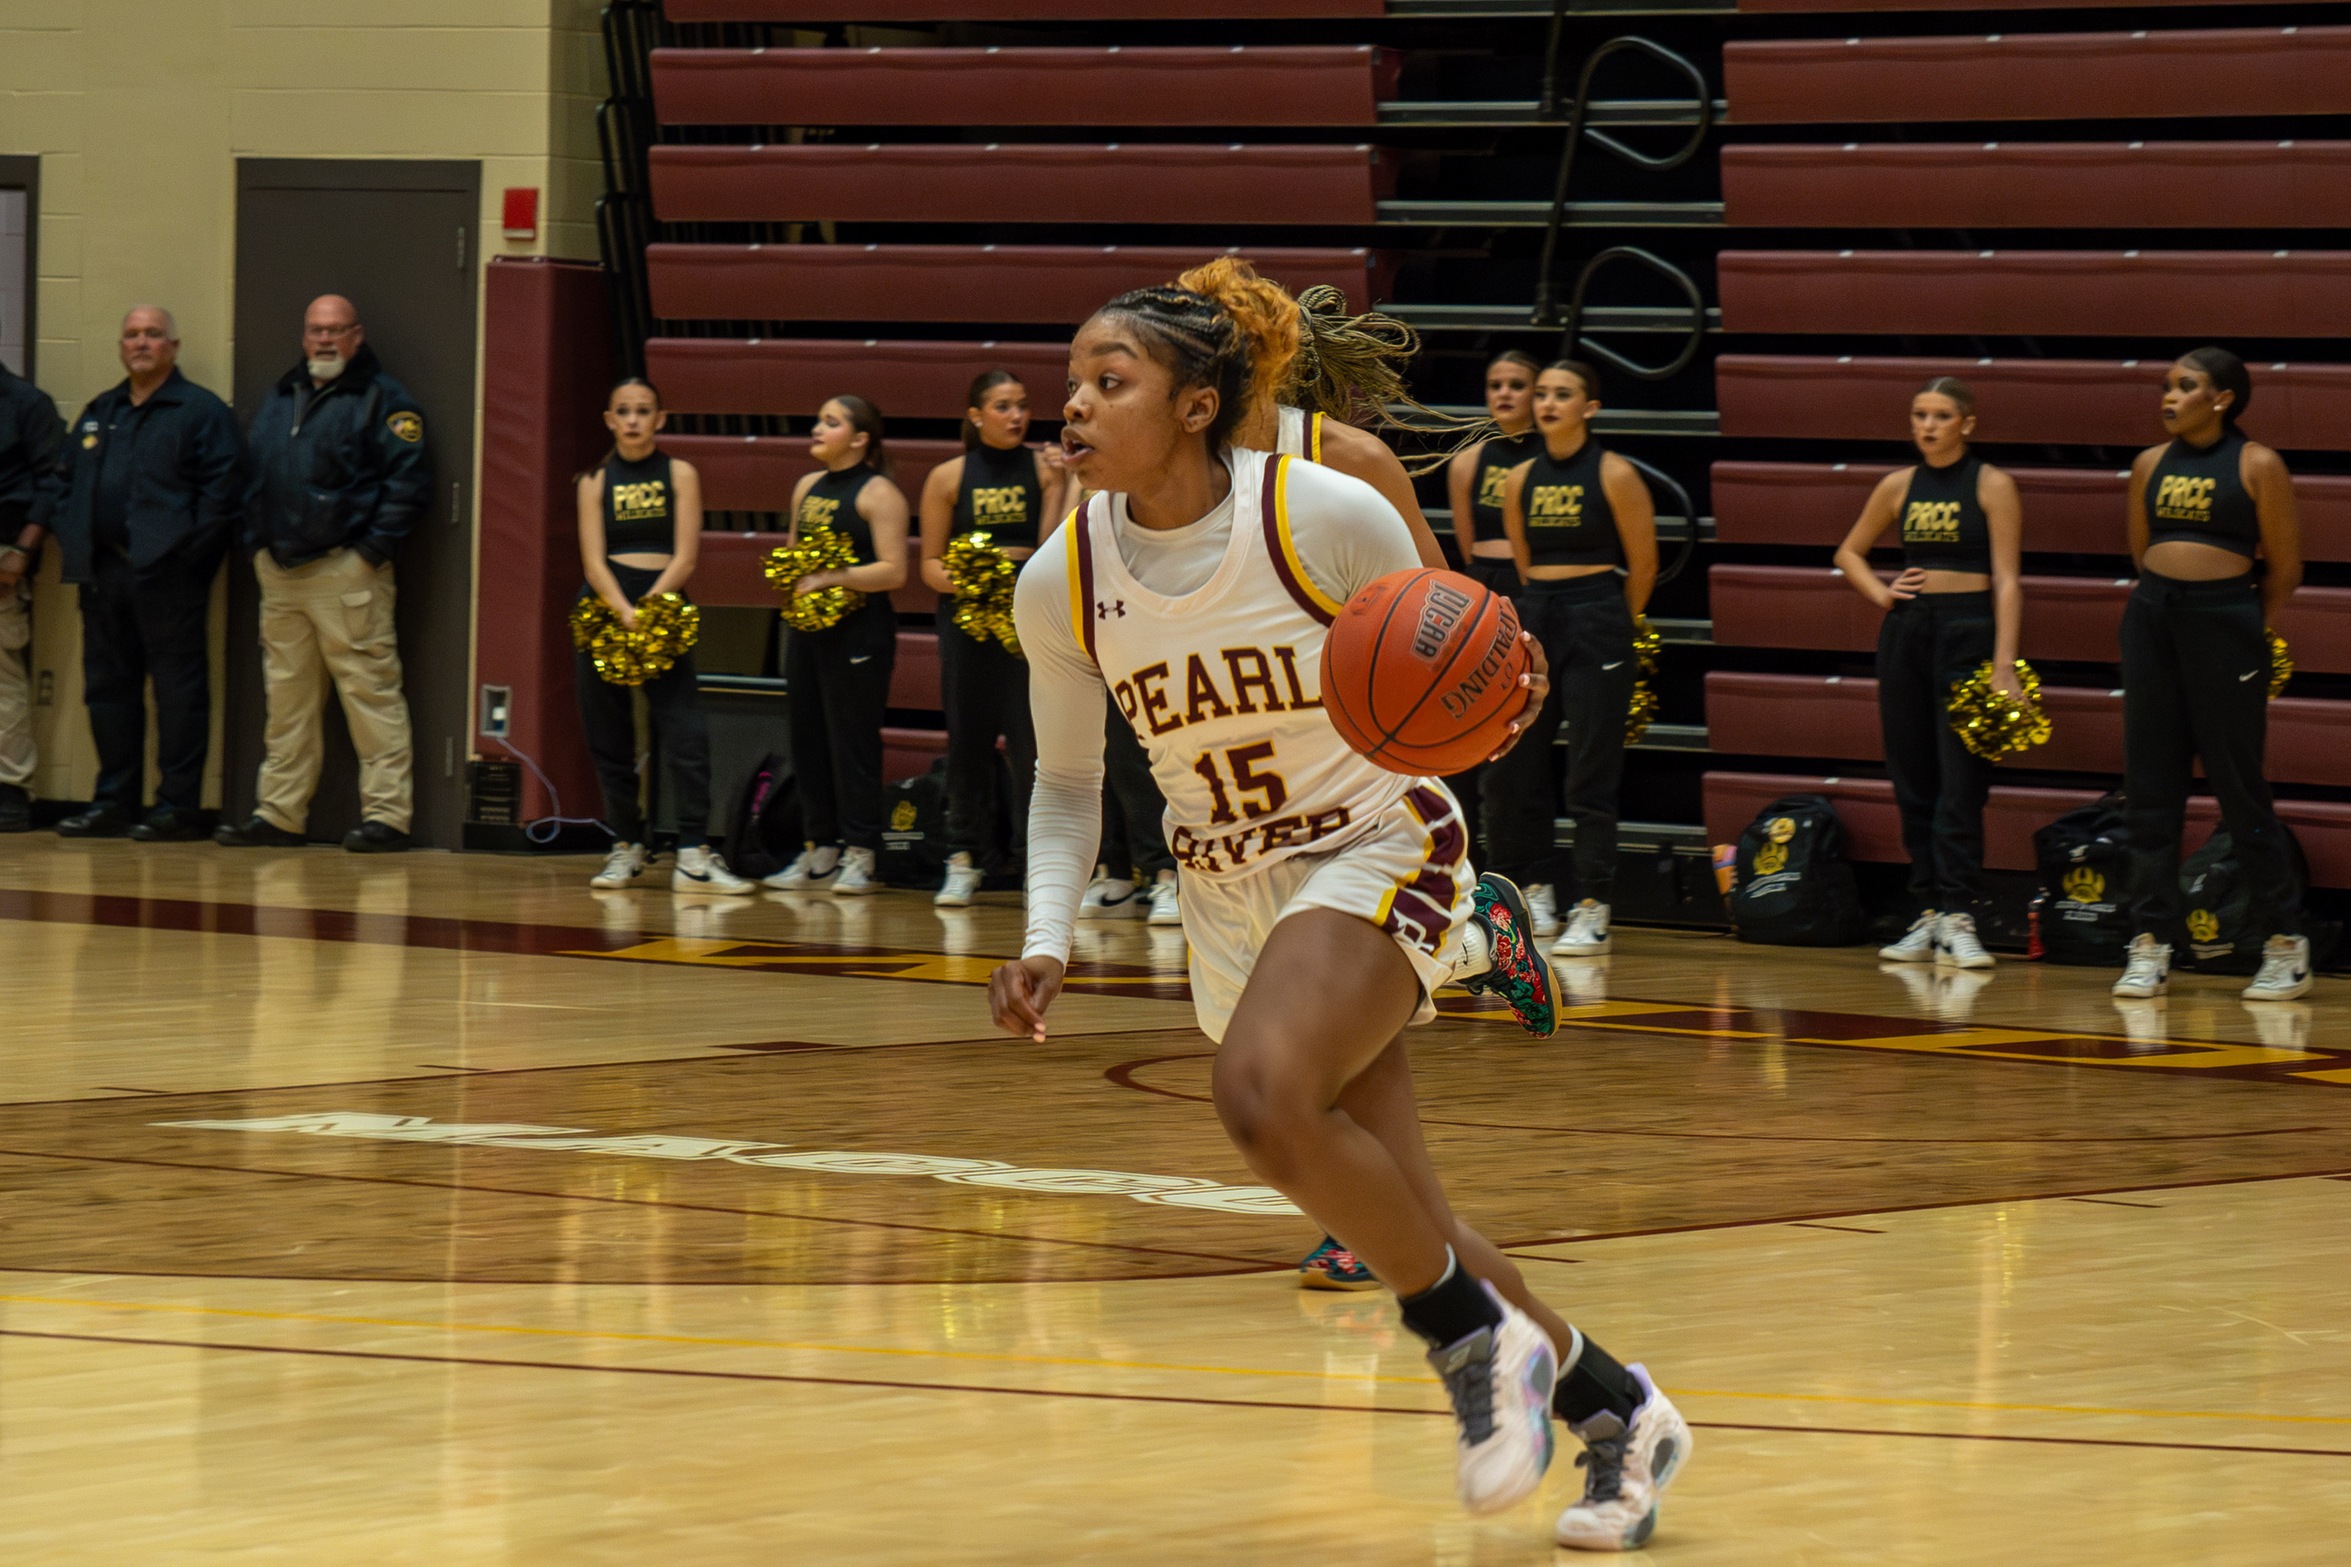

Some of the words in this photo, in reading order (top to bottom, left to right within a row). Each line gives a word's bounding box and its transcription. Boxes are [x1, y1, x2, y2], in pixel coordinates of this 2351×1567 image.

[612, 480, 666, 512] PRCC
[972, 485, 1027, 516] PRCC
[1528, 485, 1585, 516] PRCC
[2156, 474, 2217, 510] PRCC
[1903, 501, 1962, 532] PRCC
[1412, 579, 1473, 661] NJCAA
[1114, 645, 1327, 740] PEARL
[1194, 738, 1288, 824] 15
